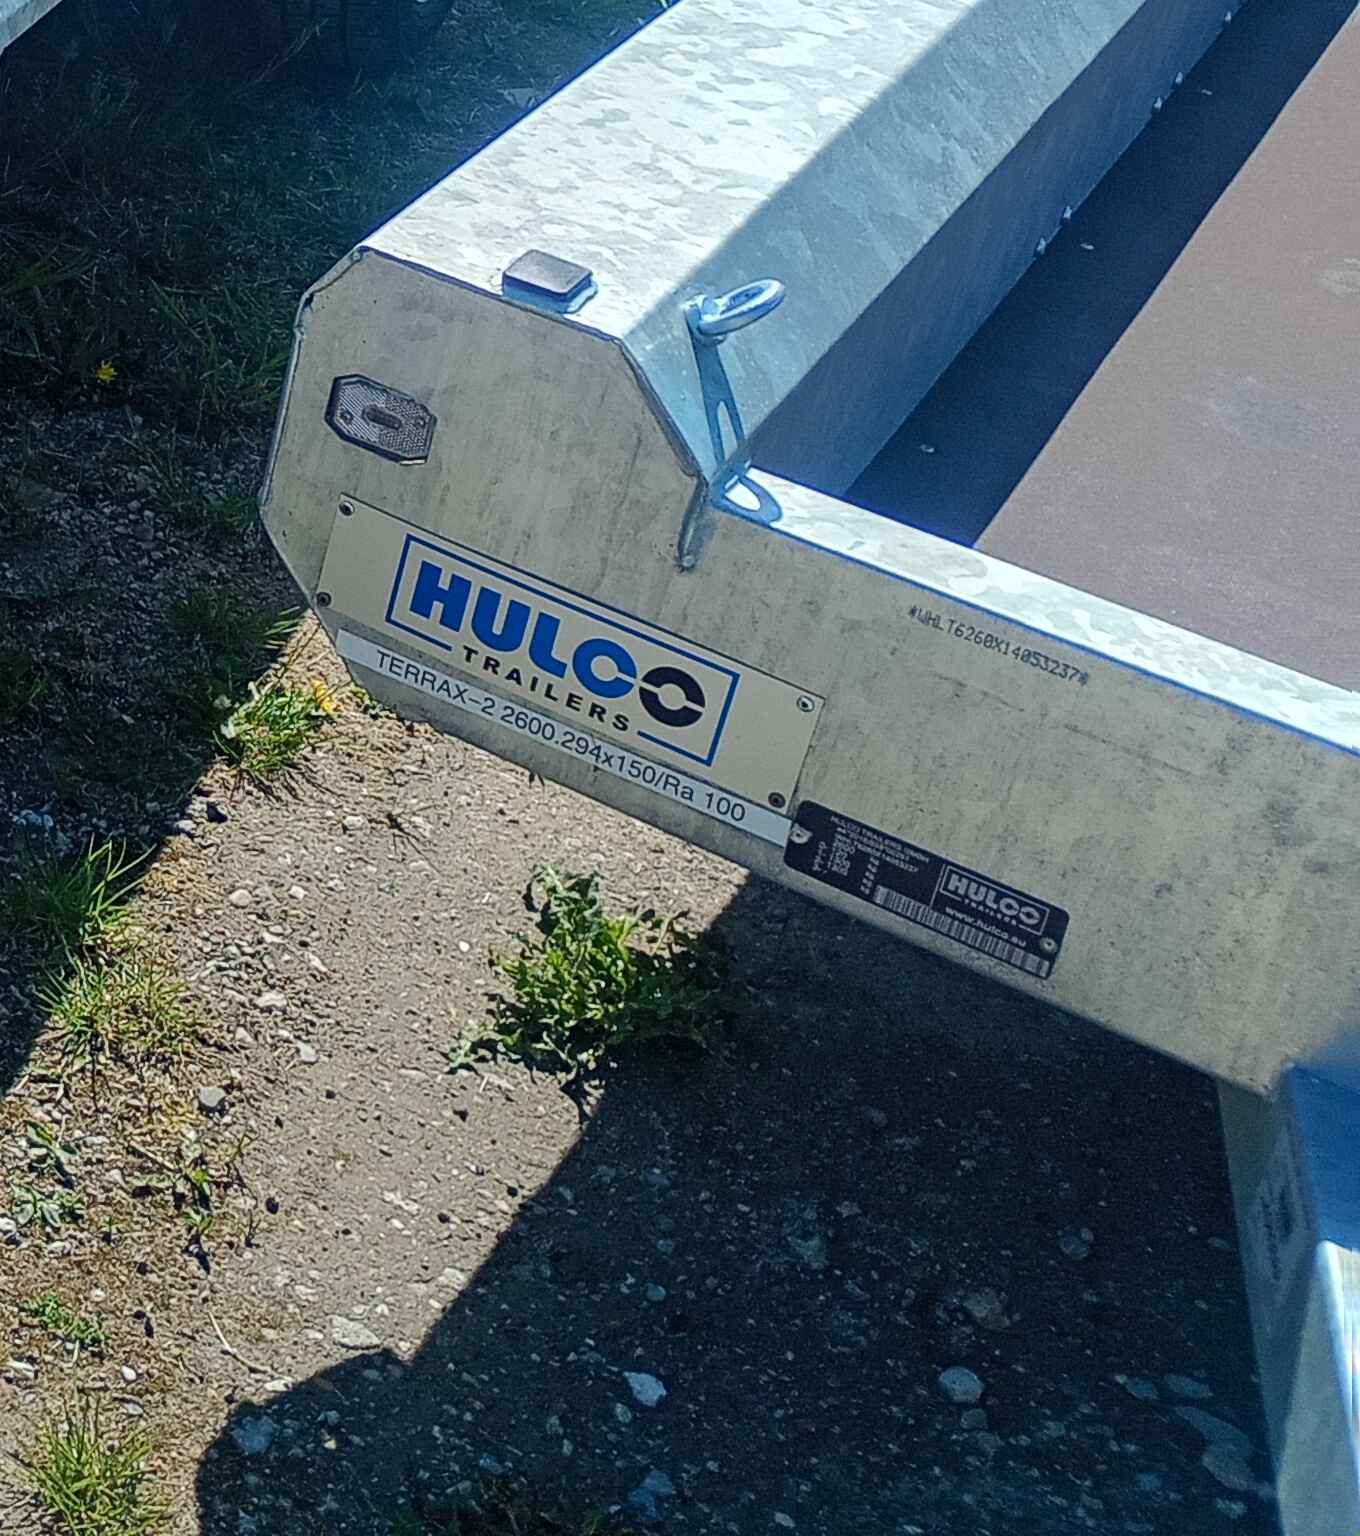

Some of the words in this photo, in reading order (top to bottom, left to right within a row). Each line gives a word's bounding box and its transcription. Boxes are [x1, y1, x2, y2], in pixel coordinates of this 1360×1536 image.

[408, 560, 707, 728] HULCO
[463, 644, 631, 732] TRAILERS
[500, 704, 694, 804] 2600.294x150/Ra
[705, 791, 747, 823] 100
[945, 906, 1026, 947] www.hulco.eu
[948, 873, 1039, 925] HULCO
